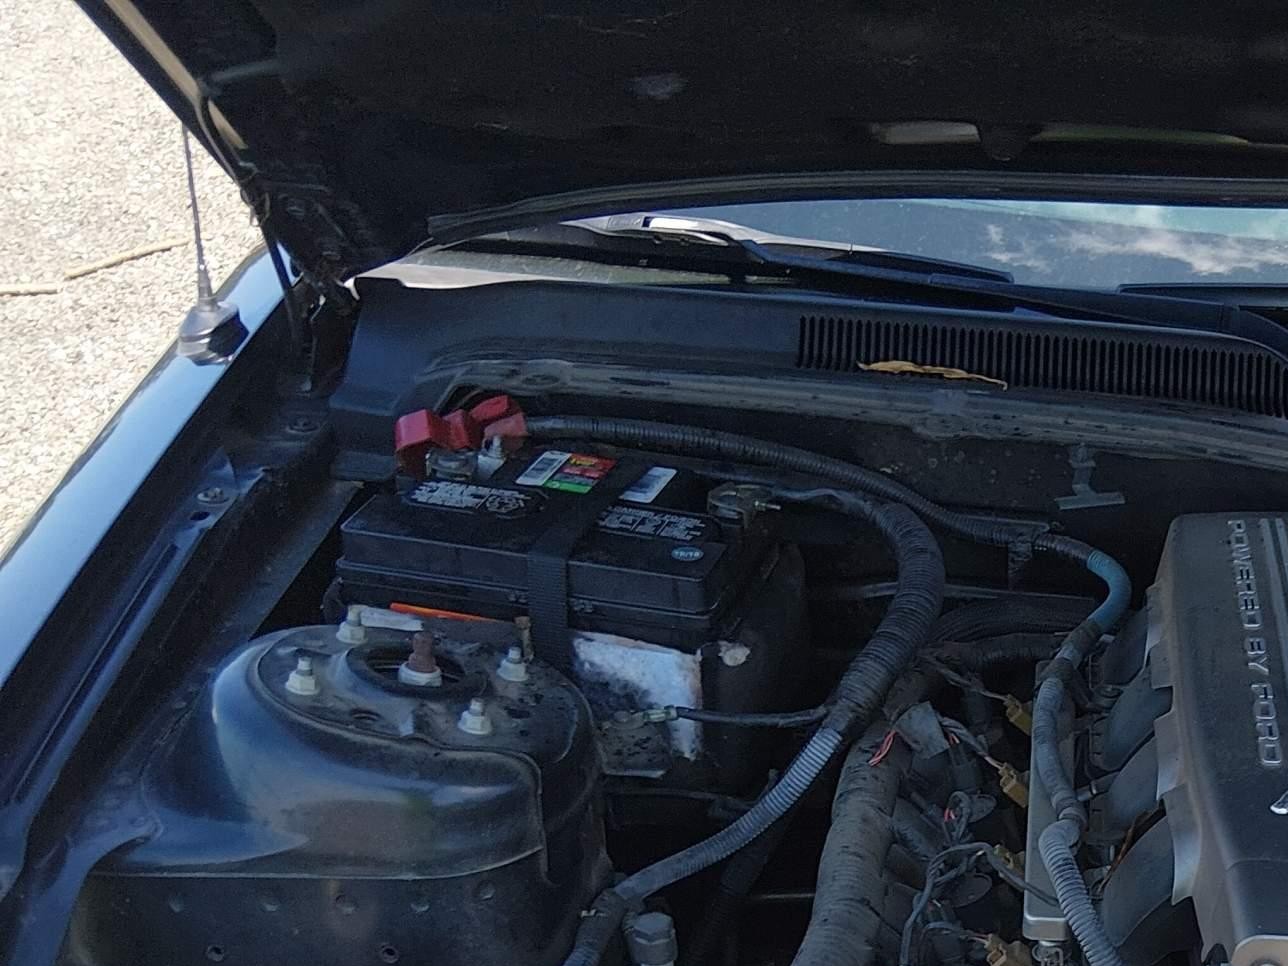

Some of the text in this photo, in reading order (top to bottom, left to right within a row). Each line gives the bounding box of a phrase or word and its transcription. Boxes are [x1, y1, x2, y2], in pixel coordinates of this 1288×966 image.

[1228, 519, 1283, 767] POWERED BY FORD
